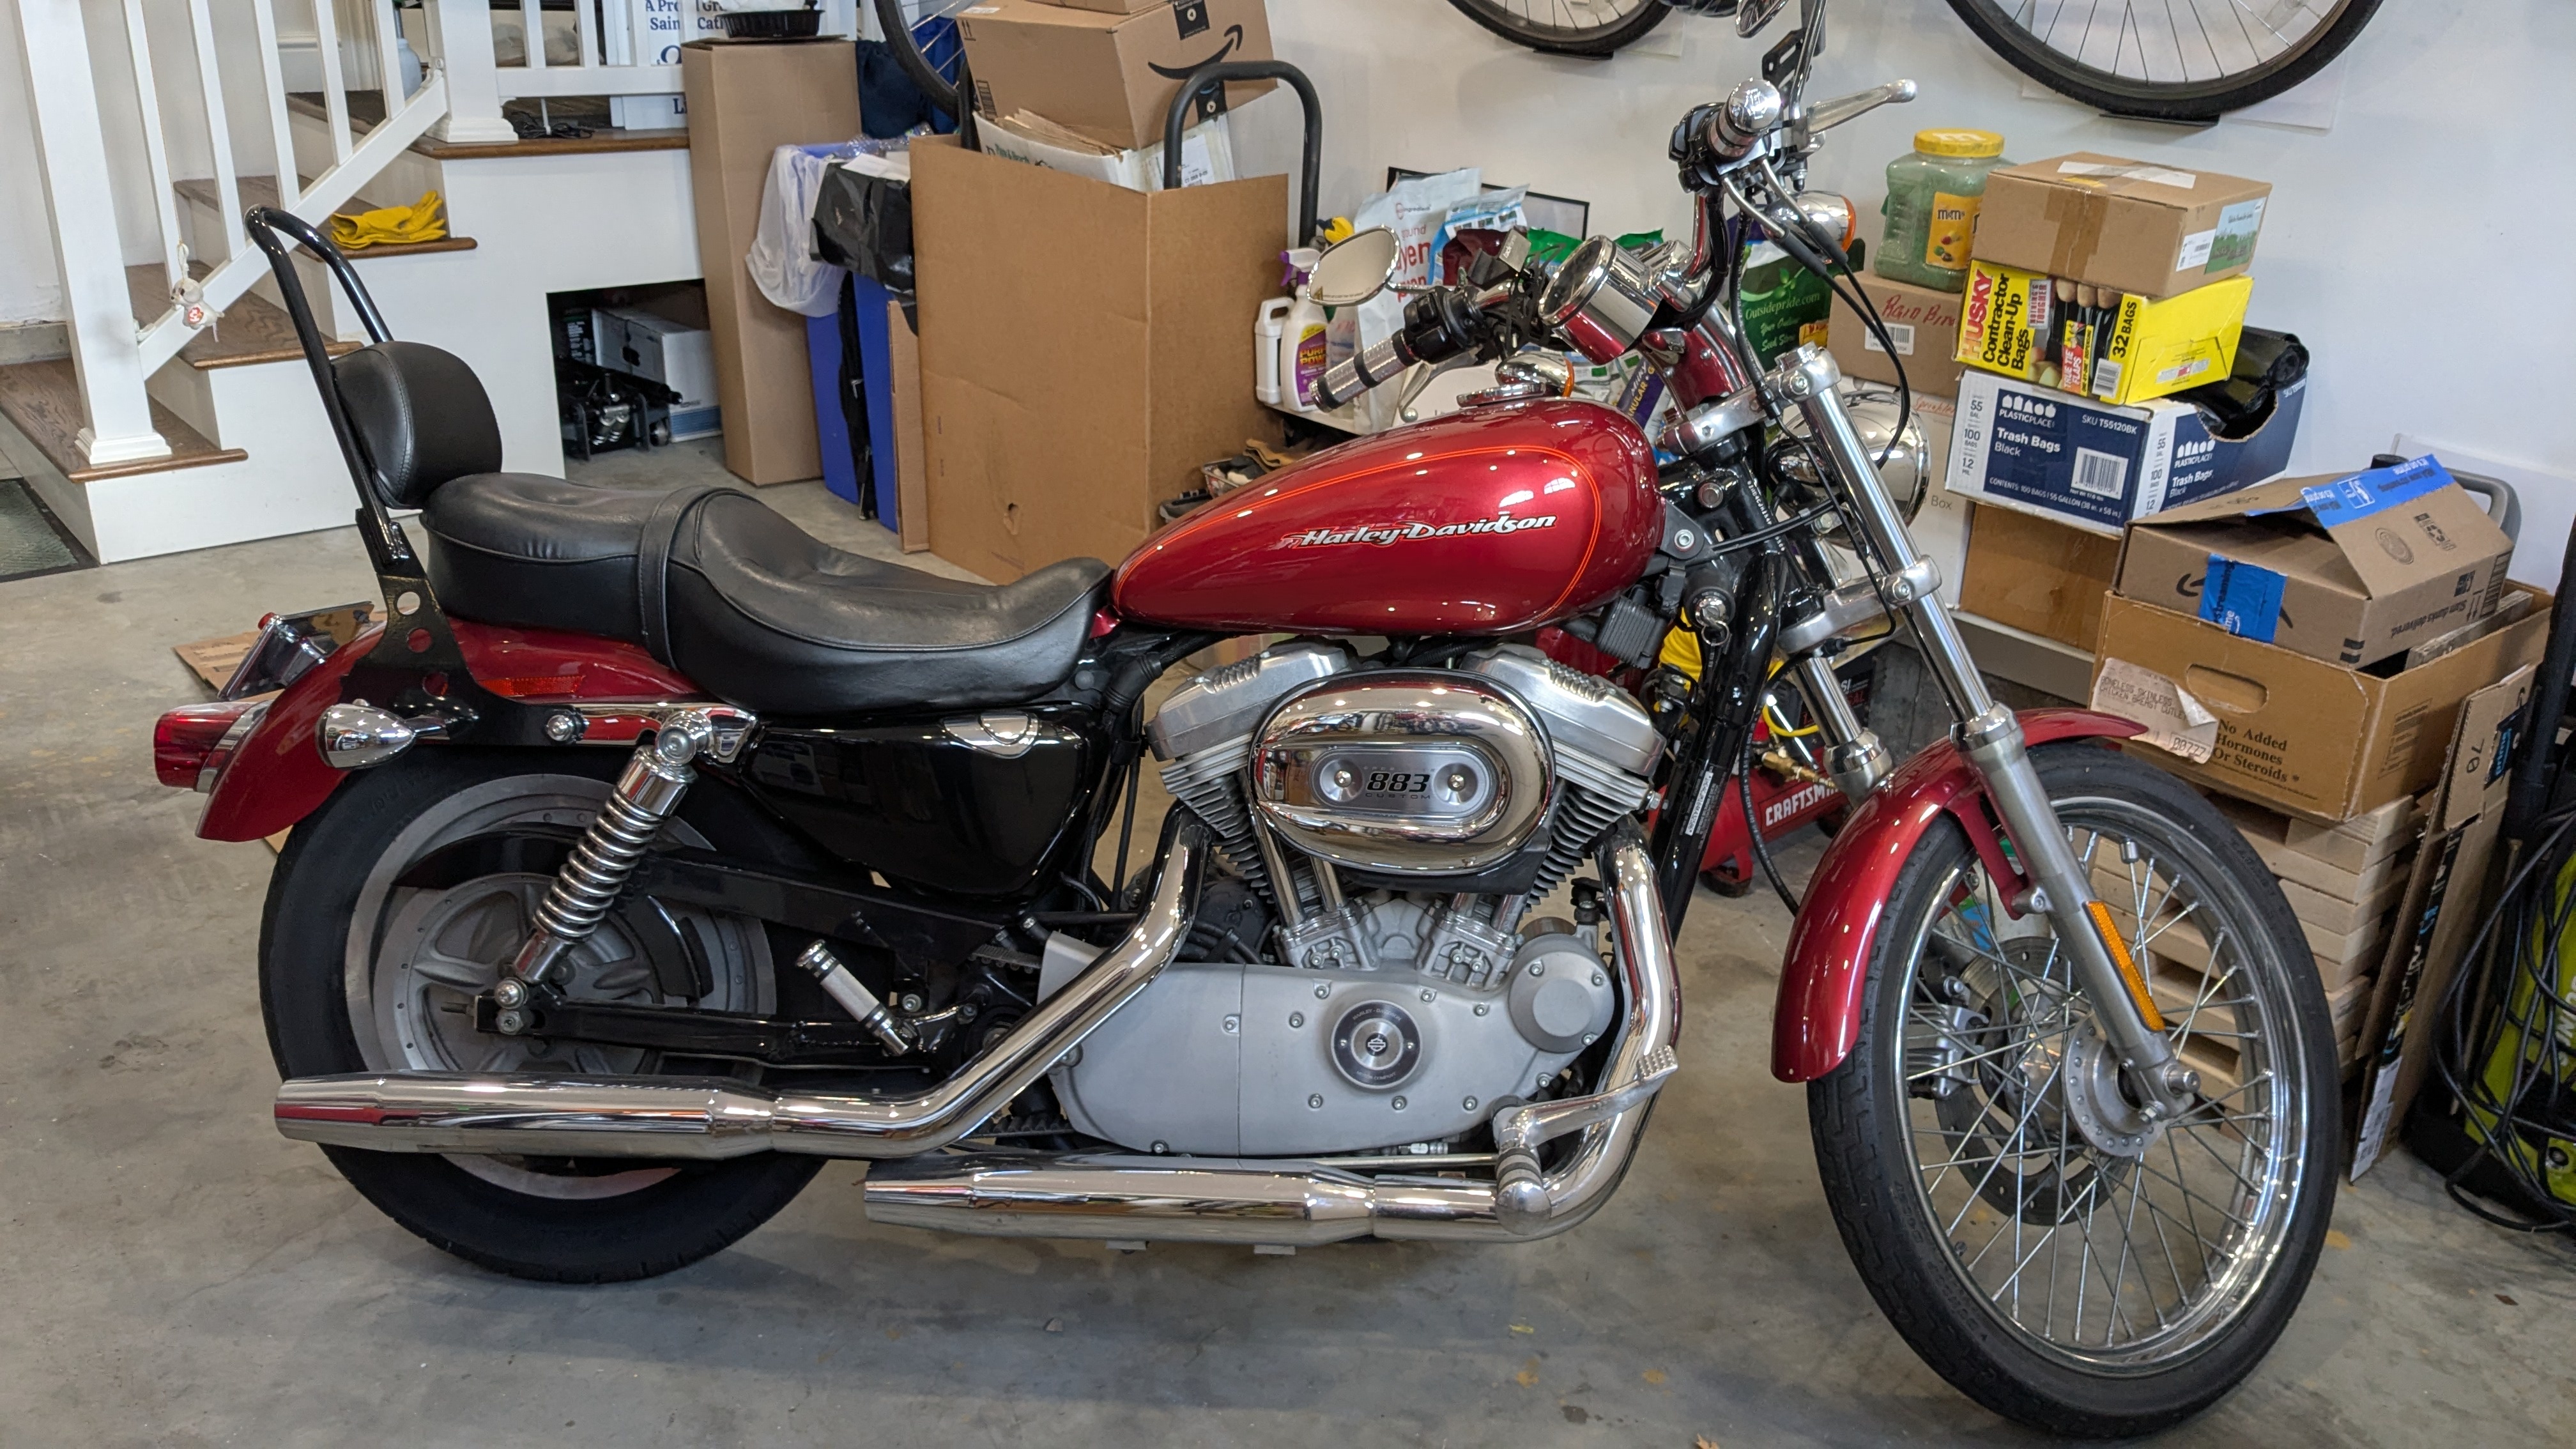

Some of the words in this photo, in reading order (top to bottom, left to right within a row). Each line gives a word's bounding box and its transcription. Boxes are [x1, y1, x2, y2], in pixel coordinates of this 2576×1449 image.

[1961, 268, 1993, 360] HUSKY
[1982, 272, 2010, 363] Contractor
[2036, 284, 2047, 324] TOUGHER
[1997, 293, 2023, 367] Clean-Up
[2113, 334, 2129, 358] 32
[2121, 301, 2137, 335] BAGS
[2011, 328, 2030, 371] Bags
[1970, 400, 1982, 411] 55
[1999, 409, 2051, 427] PLASTICPLACE
[1964, 429, 1981, 441] 100
[1997, 427, 2028, 445] Trash
[2030, 435, 2060, 452] Bags
[2082, 414, 2097, 426] SKU
[2099, 418, 2137, 434] T55120BK
[1994, 441, 2021, 457] Black
[1989, 477, 2019, 491] CONTENTS:
[2020, 485, 2031, 494] 100
[2031, 488, 2046, 498] BAGS
[2058, 494, 2082, 509] GALLON
[2172, 473, 2194, 487] Trash
[2194, 470, 2214, 482] Bags
[1931, 494, 1952, 510] Box
[1289, 516, 1557, 546] Harley-Davidson
[2215, 733, 2283, 765] Hormones
[2219, 719, 2236, 733] No
[2243, 728, 2288, 751] Added
[2214, 747, 2230, 761] Or
[2234, 755, 2288, 783] Steroids
[1367, 772, 1431, 792] 883
